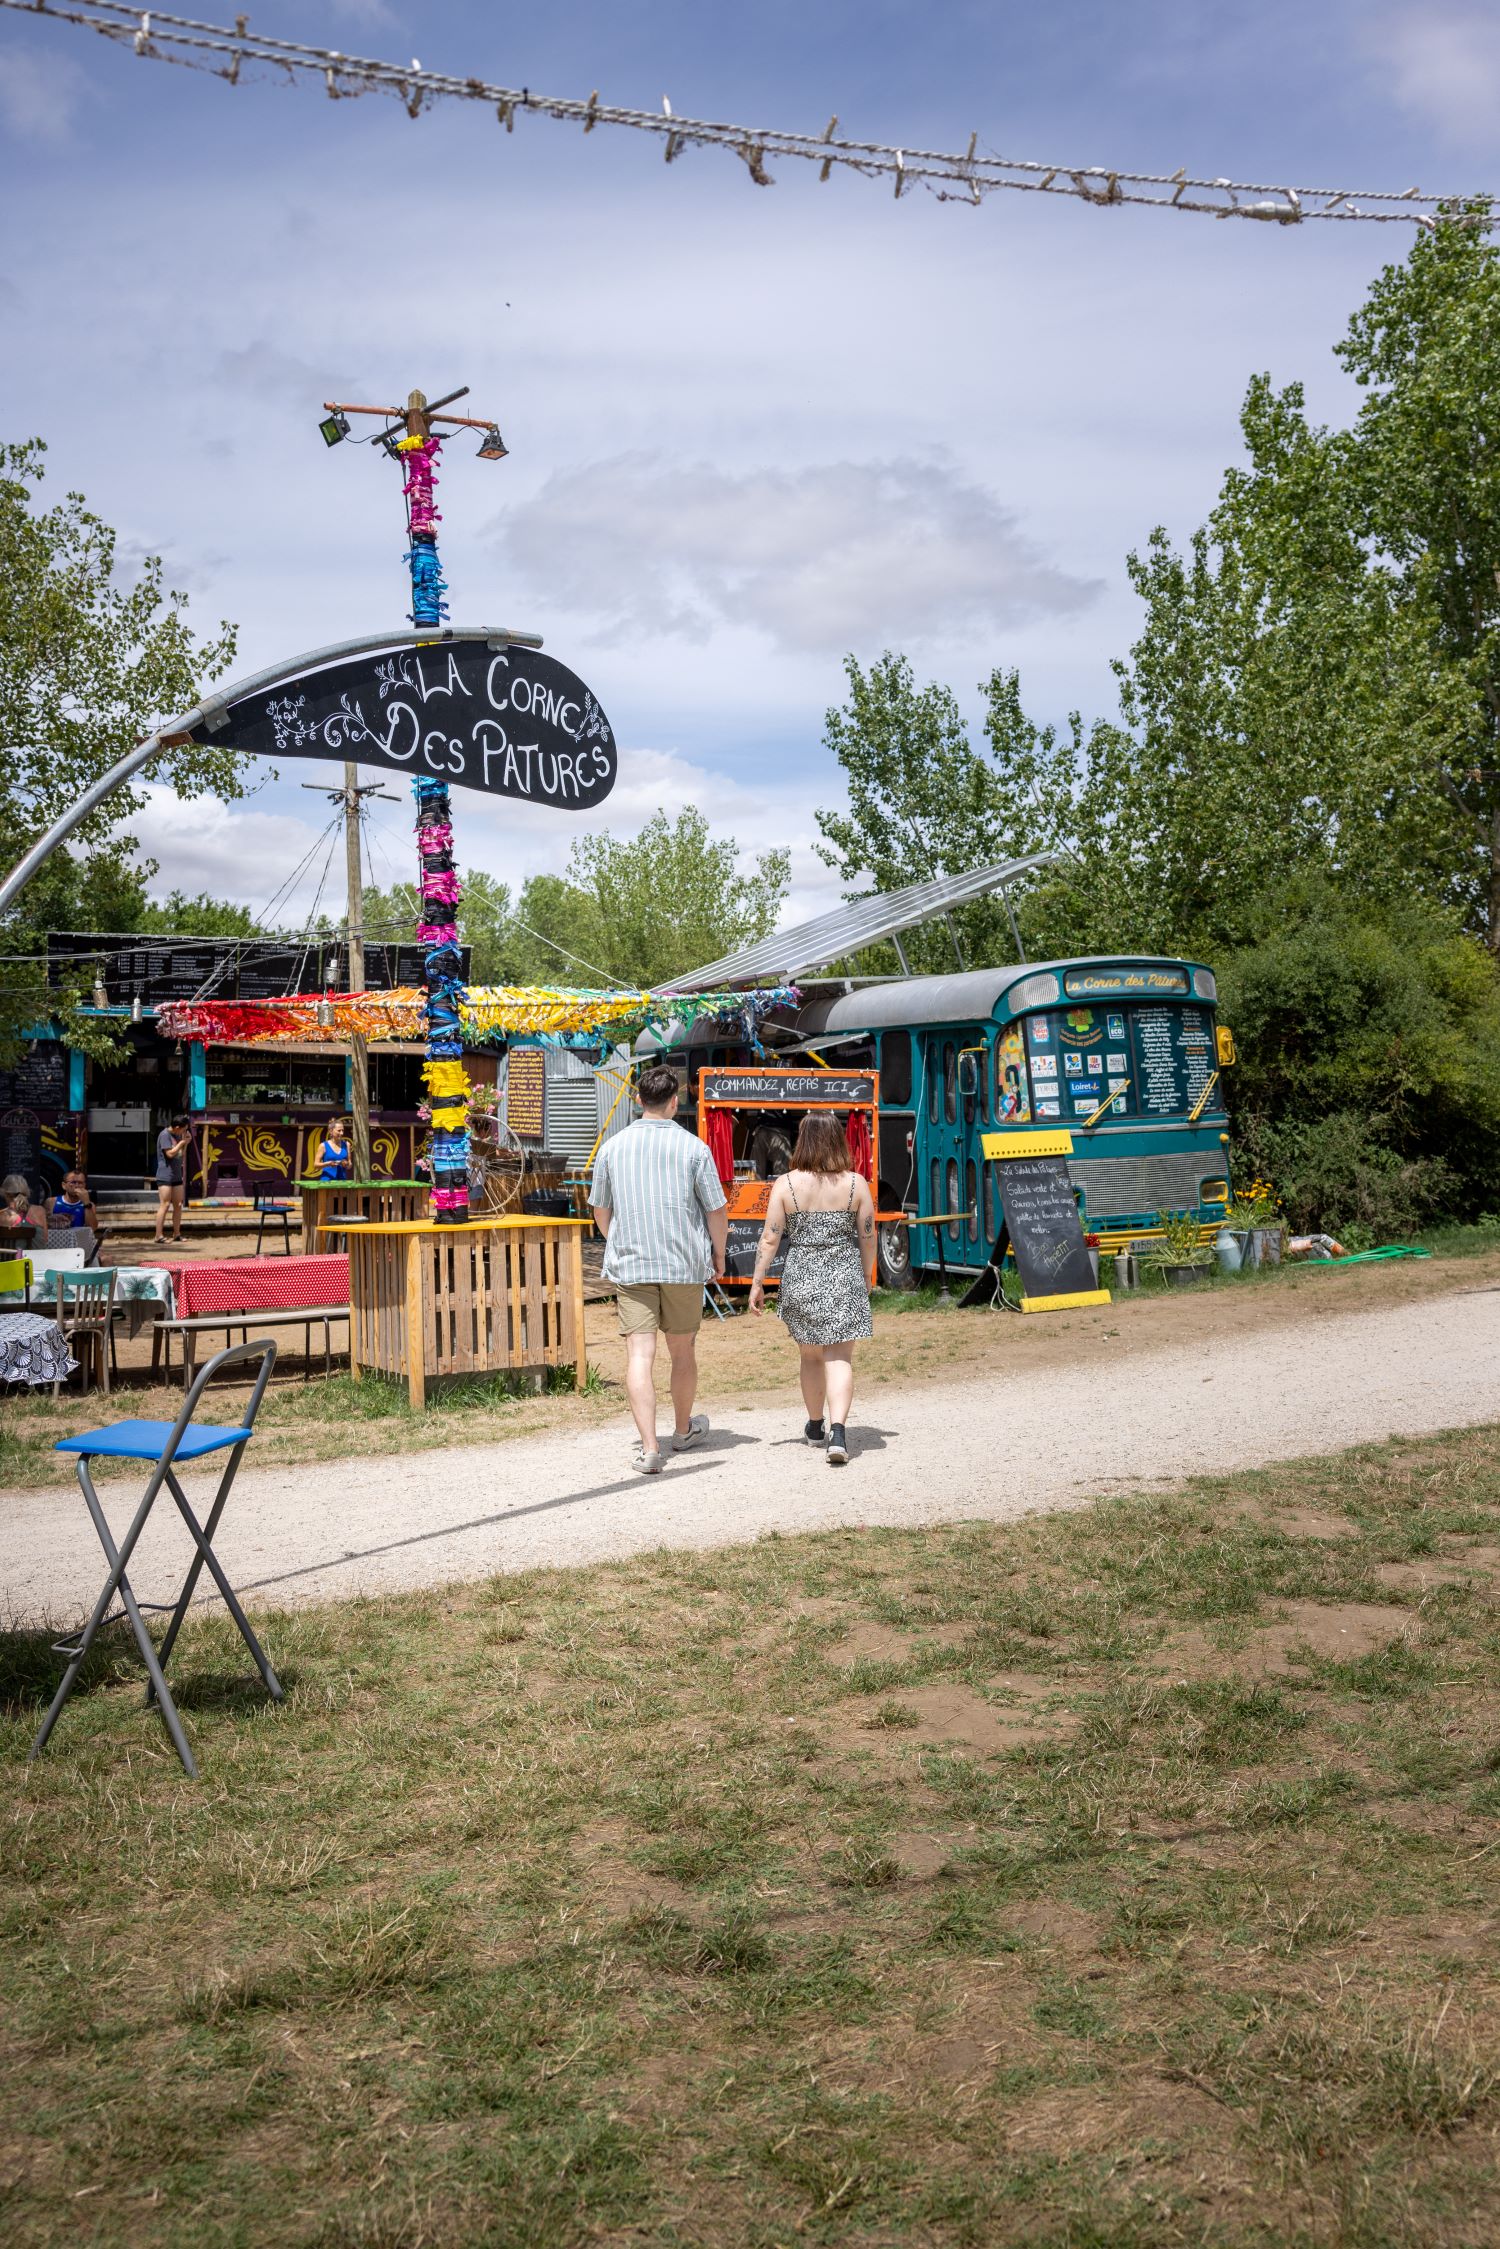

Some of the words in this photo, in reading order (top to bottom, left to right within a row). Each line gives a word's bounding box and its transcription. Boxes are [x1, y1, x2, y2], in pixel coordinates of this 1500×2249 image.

[415, 652, 473, 703] LA
[487, 655, 582, 734] CORNE
[381, 701, 466, 775] DES
[472, 719, 611, 798] PATURES
[1065, 980, 1082, 992] La
[1084, 976, 1122, 989] Corne
[1124, 974, 1145, 987] des
[715, 1077, 779, 1092] COMMANDEZ
[787, 1077, 819, 1092] REPAS
[824, 1082, 850, 1092] ICI
[1072, 1083, 1091, 1091] Loiret
[1006, 1182, 1032, 1196] Salade
[1032, 1183, 1049, 1193] verte
